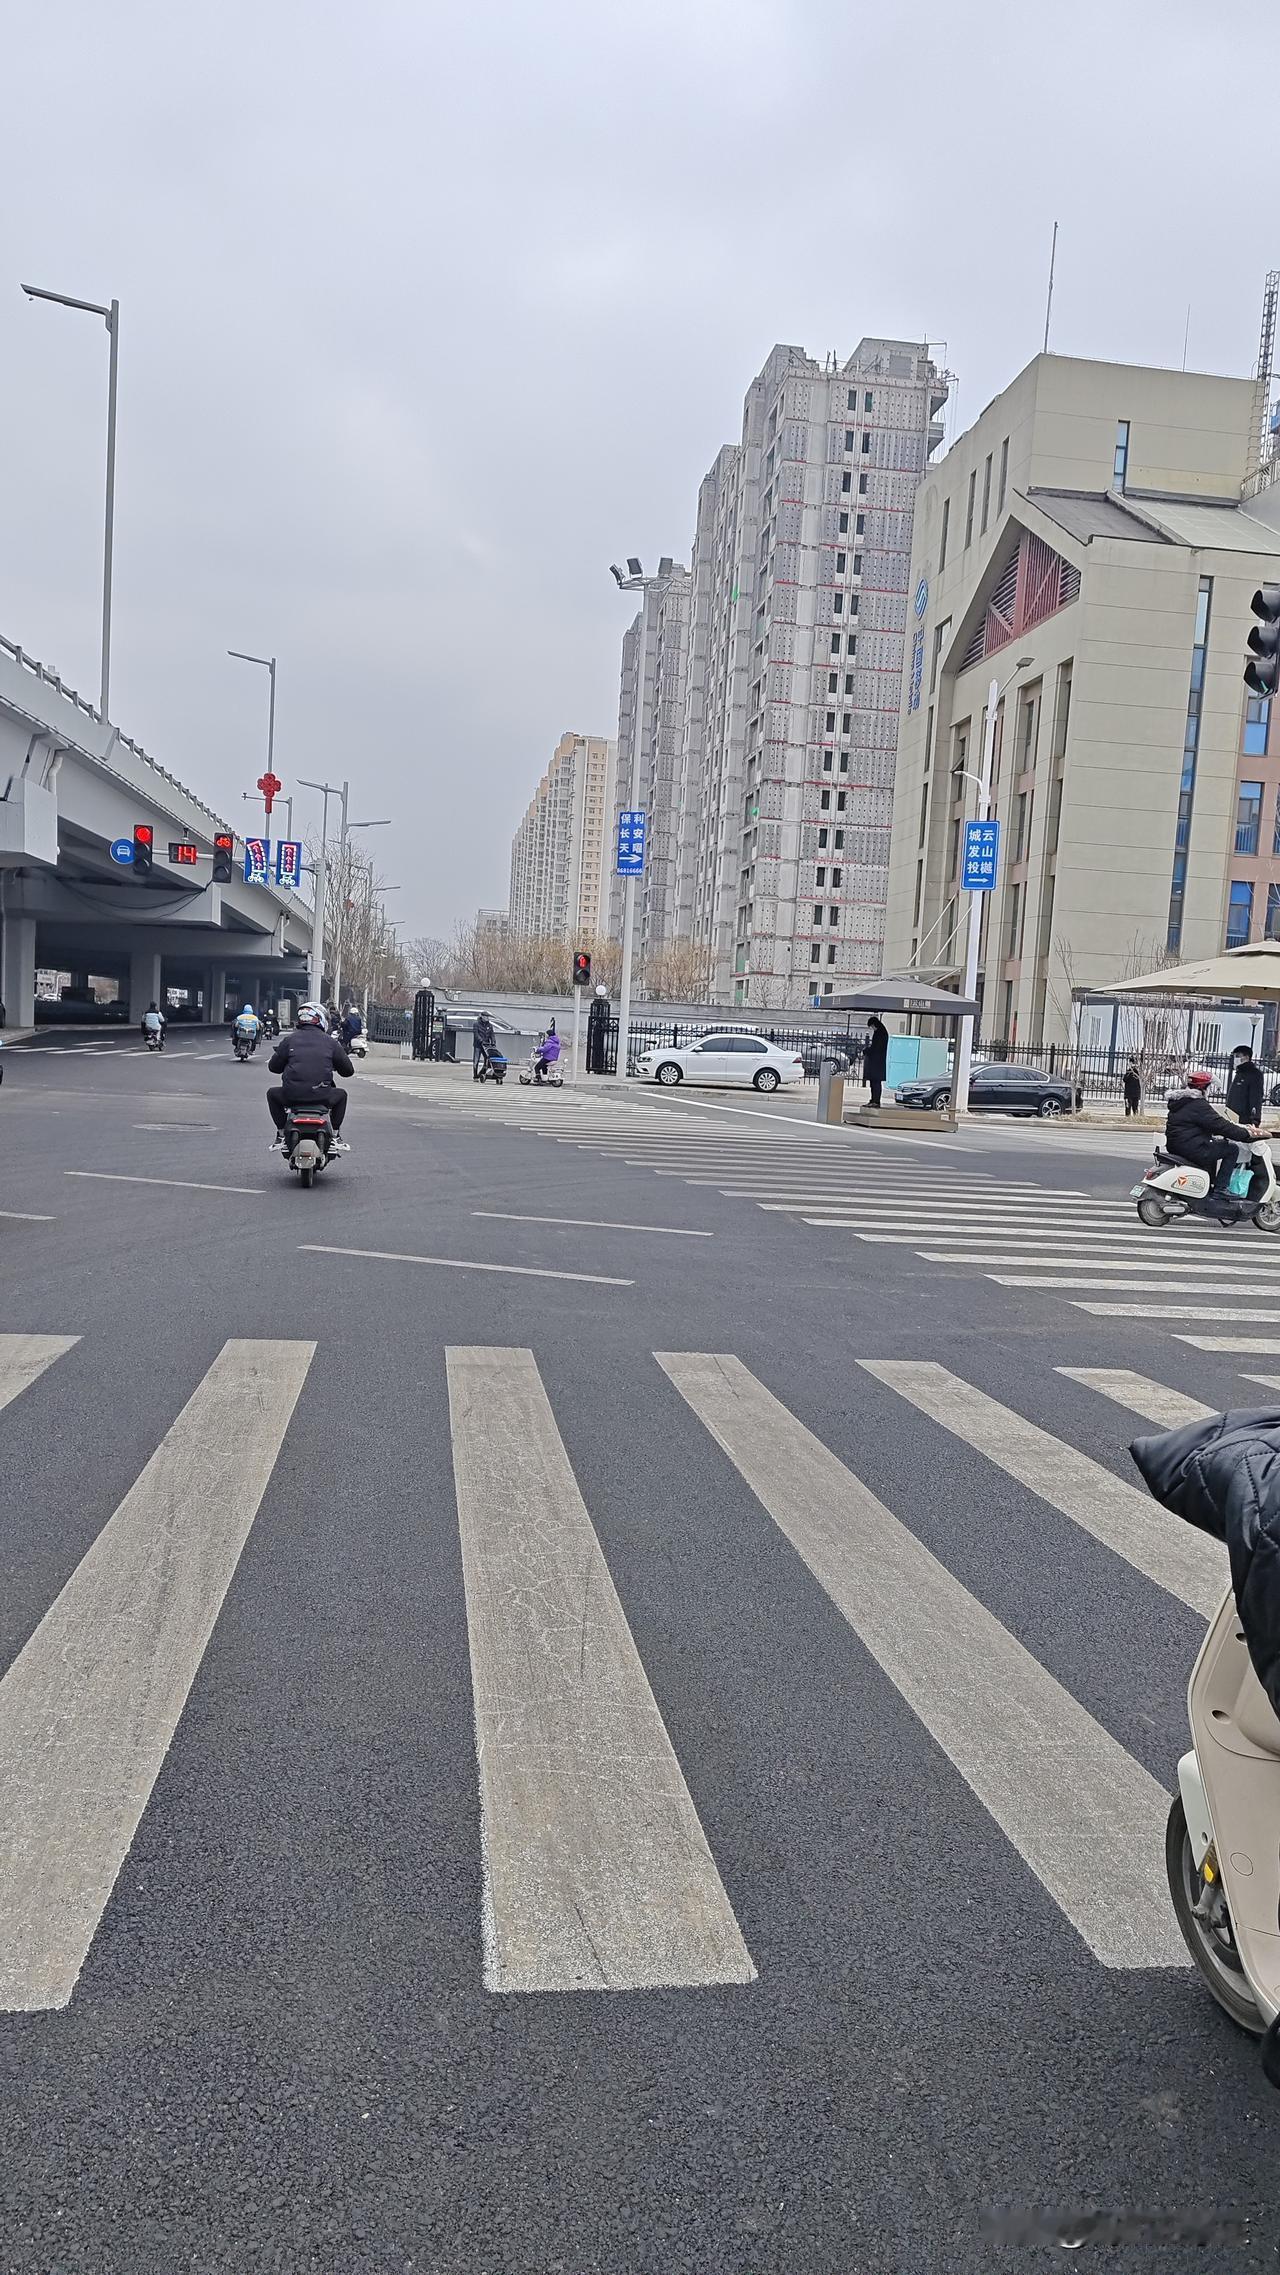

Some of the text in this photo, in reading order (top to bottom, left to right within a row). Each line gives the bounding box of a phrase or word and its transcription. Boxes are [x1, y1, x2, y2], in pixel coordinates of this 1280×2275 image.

[621, 813, 645, 825] 保利
[619, 828, 643, 839] 长安
[178, 846, 195, 862] 14
[967, 828, 981, 874] 城发投
